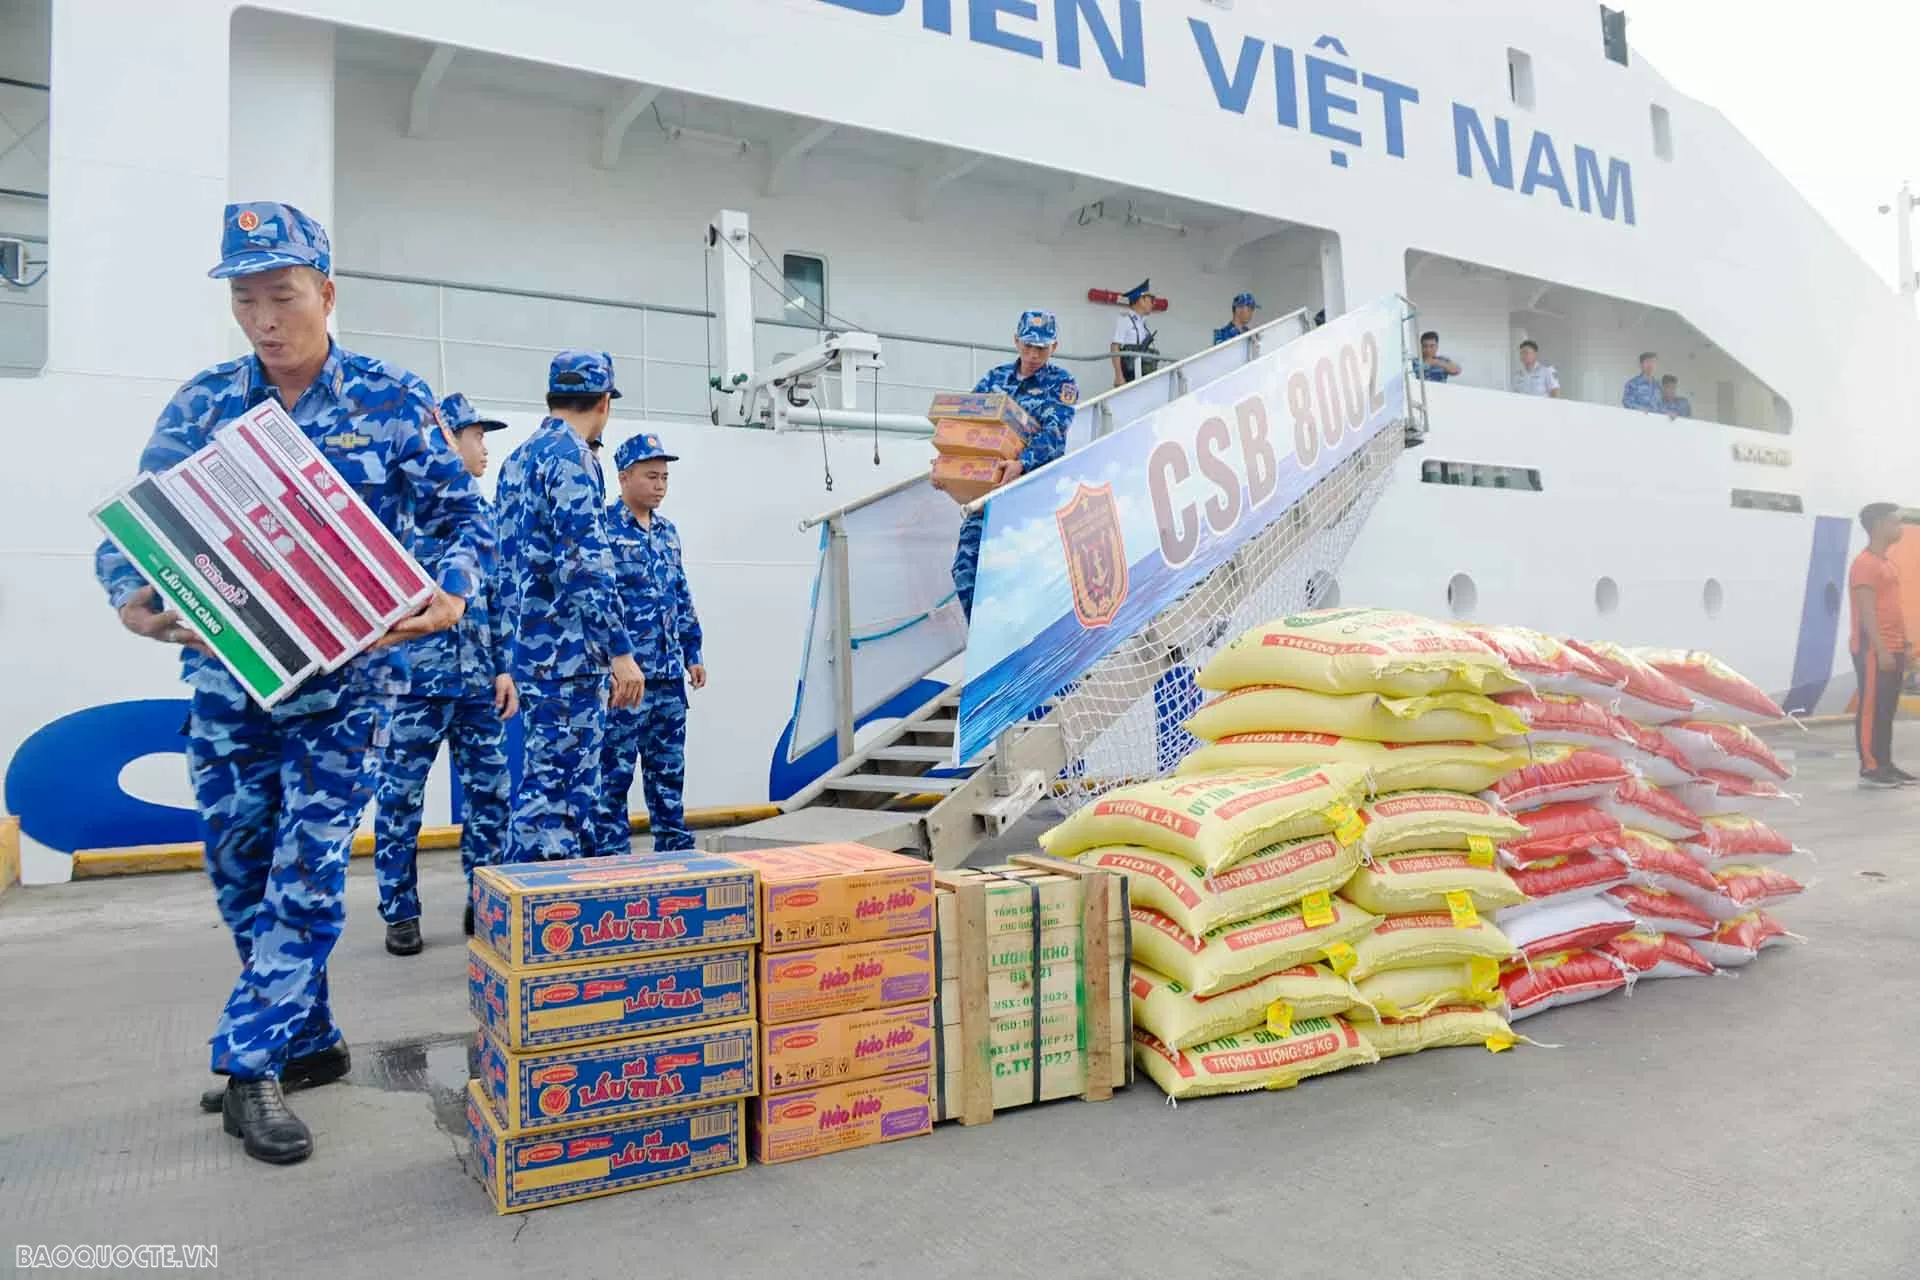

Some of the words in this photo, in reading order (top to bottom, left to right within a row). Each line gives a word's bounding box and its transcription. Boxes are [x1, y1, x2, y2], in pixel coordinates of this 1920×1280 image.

[1188, 17, 1419, 169] VIỆT
[1452, 102, 1636, 226] NAM
[1148, 392, 1279, 570] CSB
[1287, 329, 1386, 470] 8002
[1303, 1042, 1315, 1056] 25
[1317, 1037, 1333, 1051] KG
